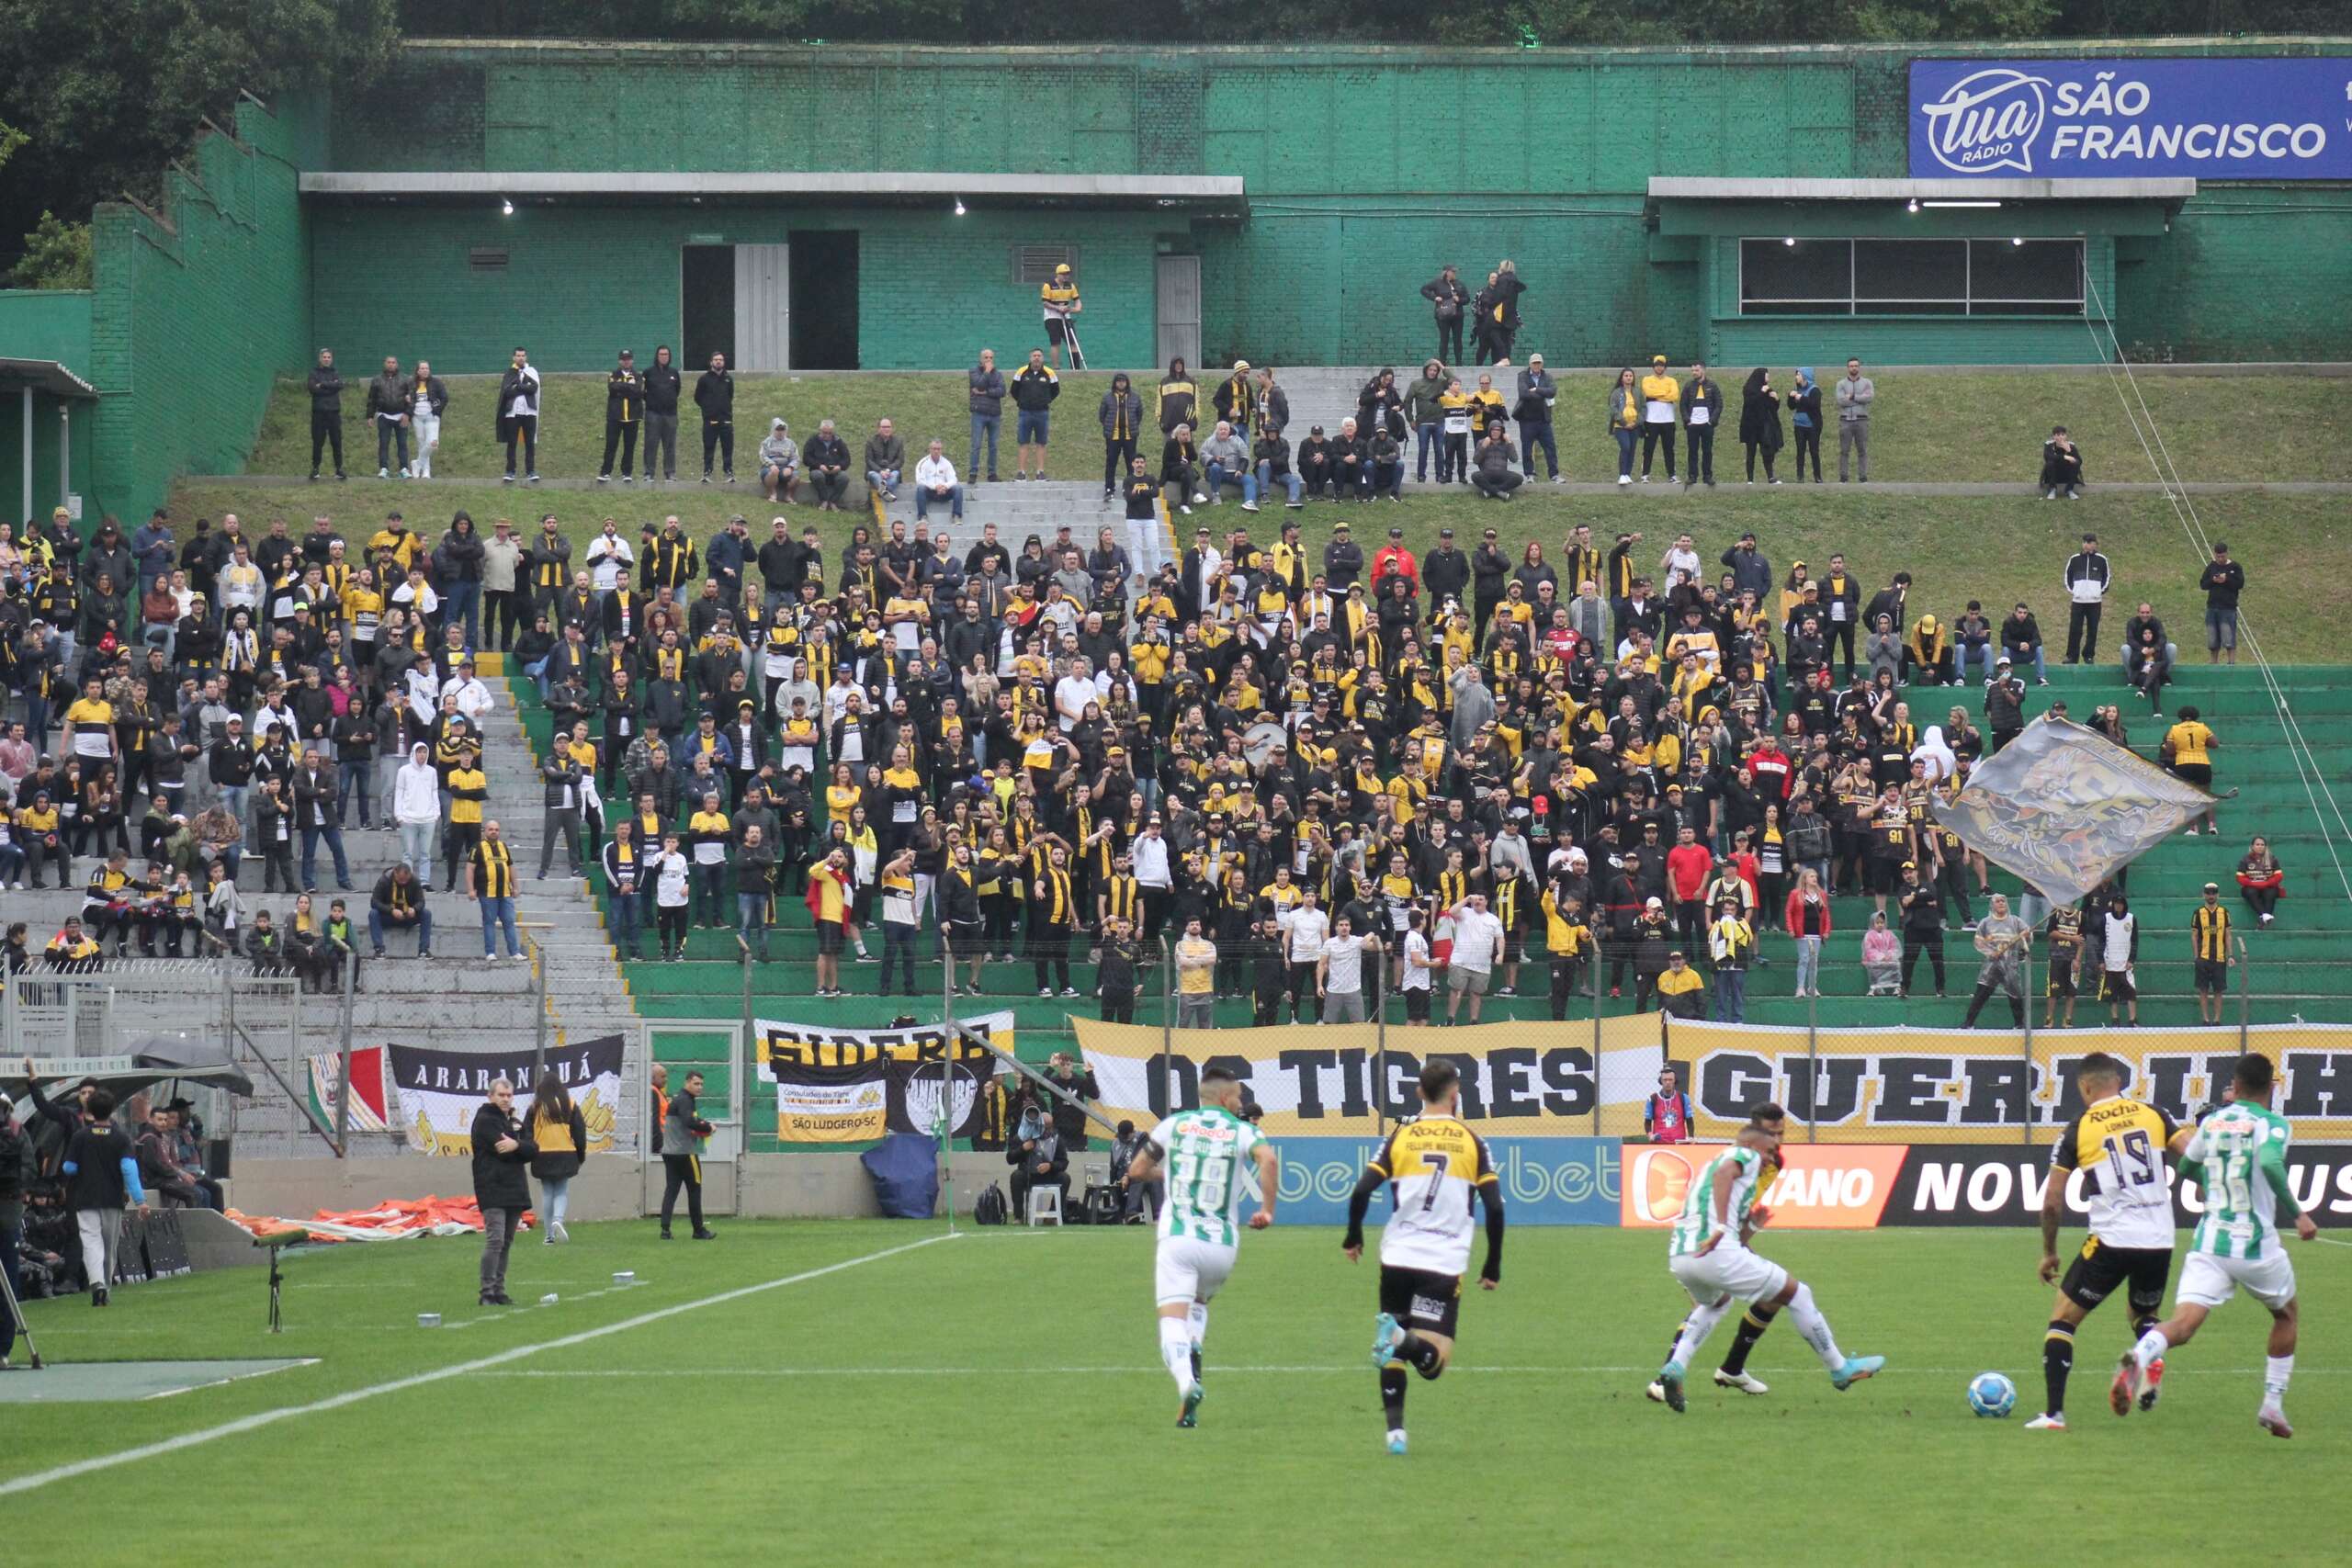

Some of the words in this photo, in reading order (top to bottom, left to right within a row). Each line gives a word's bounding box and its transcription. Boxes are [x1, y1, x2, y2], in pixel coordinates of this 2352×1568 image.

[2052, 72, 2151, 117] SÃO
[1921, 78, 2043, 153] Tua
[1961, 140, 2013, 164] RÁDIO
[2051, 122, 2326, 160] FRANCISCO
[2188, 733, 2193, 750] 1
[1910, 806, 1923, 819] 91
[1888, 829, 1903, 844] 91
[1945, 833, 1958, 847] 91
[415, 1052, 591, 1090] ARARNUÁ
[1279, 1046, 1595, 1121] TIGRES
[792, 1116, 811, 1129] SÃO
[813, 1116, 877, 1130] LUDGERO-SC
[2090, 1103, 2140, 1123] Rocha
[1409, 1124, 1464, 1138] Rocha
[2102, 1130, 2154, 1190] 19
[1422, 1154, 1447, 1212] 7
